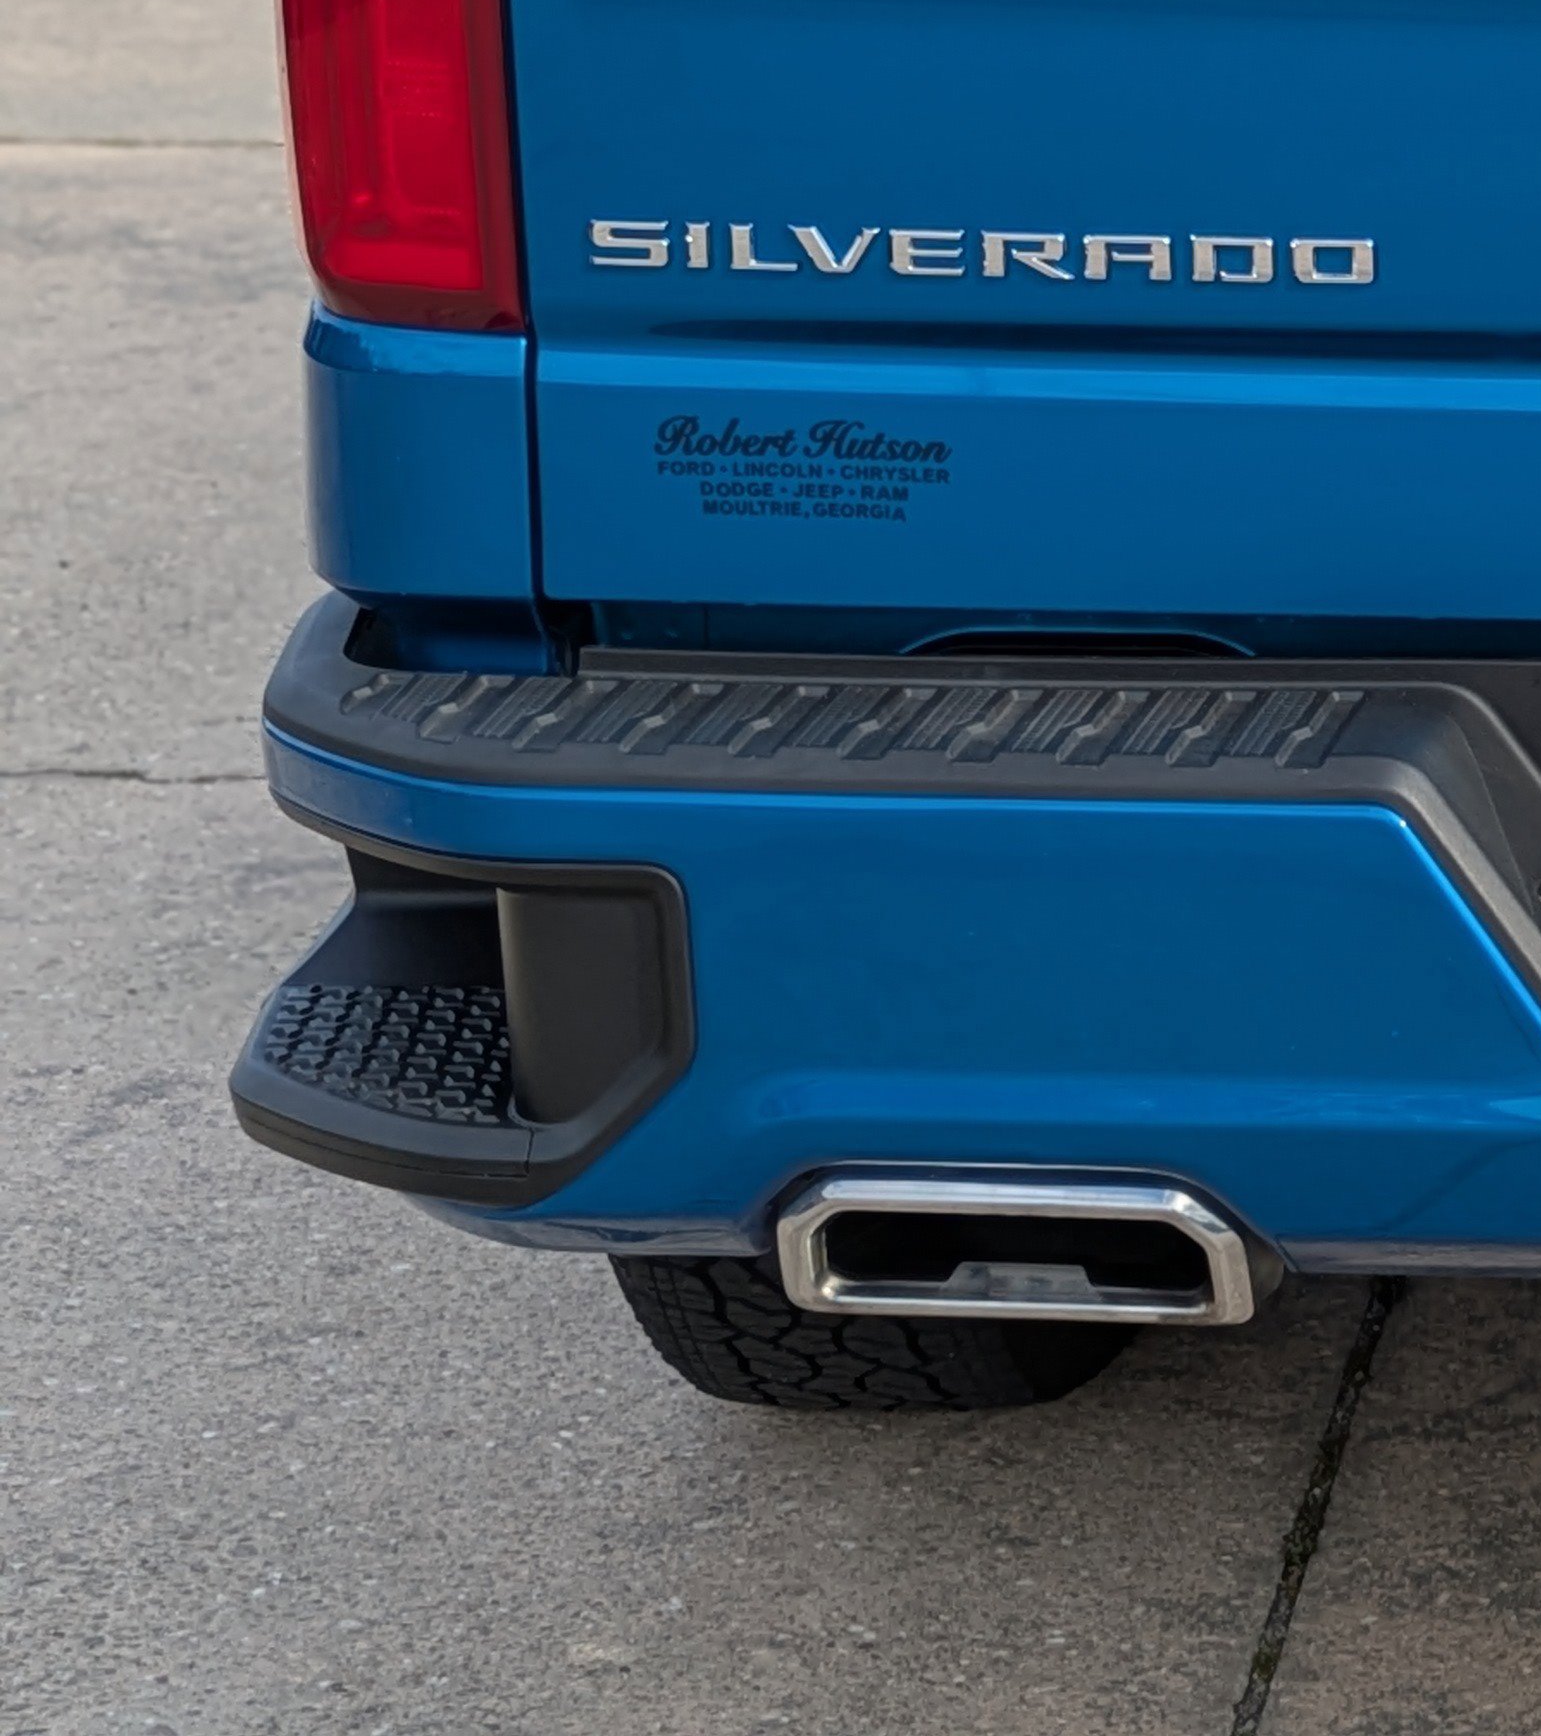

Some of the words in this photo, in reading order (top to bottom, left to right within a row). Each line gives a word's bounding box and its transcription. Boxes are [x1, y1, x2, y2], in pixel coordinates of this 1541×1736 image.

[589, 219, 1377, 285] SILVERADO
[653, 414, 798, 457] Robert
[802, 419, 953, 463] Hutson
[657, 461, 715, 477] FORD
[732, 461, 823, 479] LINCOLN
[840, 464, 950, 484] CHRYSLER
[700, 481, 774, 498] DODGE
[793, 483, 844, 499] JEEP
[861, 485, 909, 501] RAM
